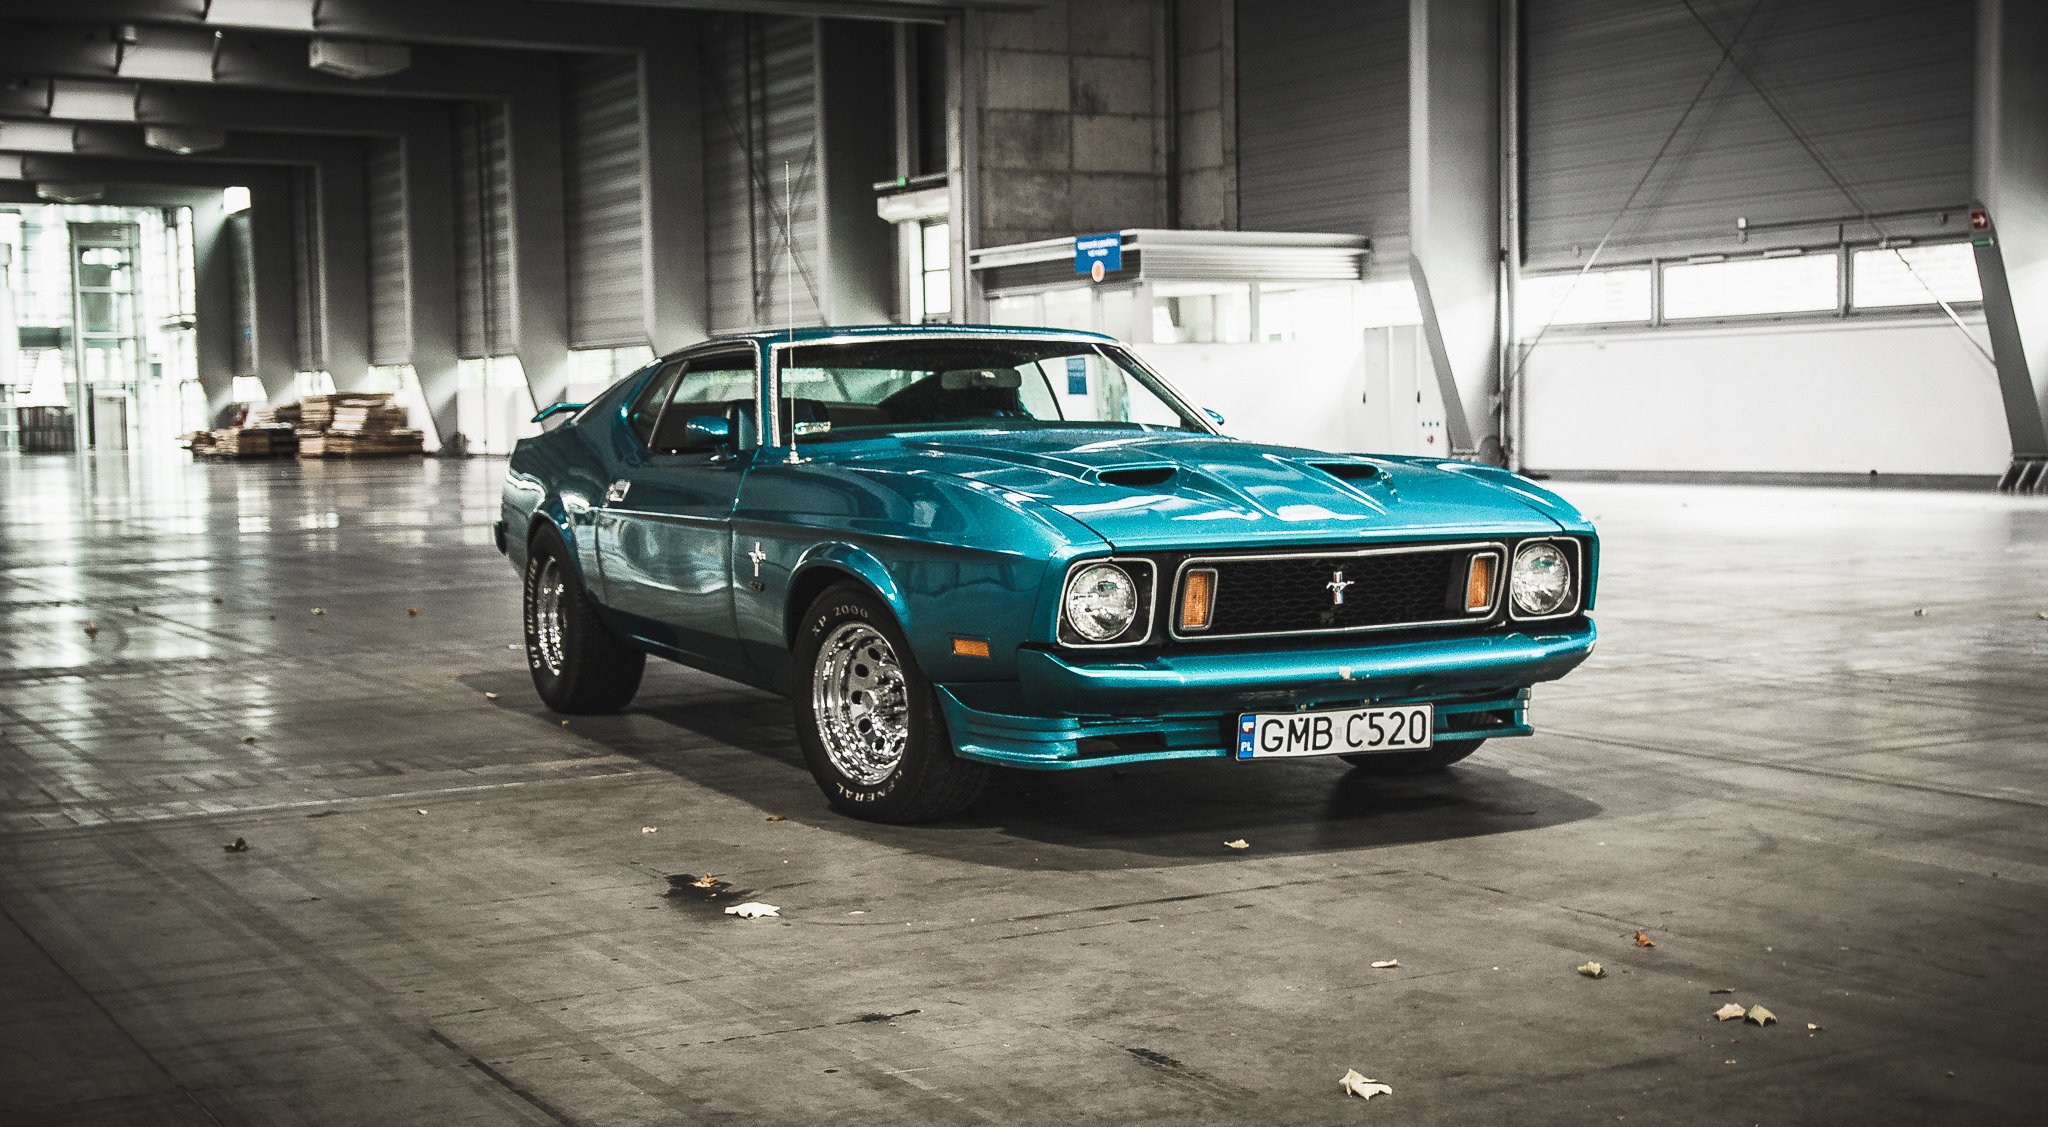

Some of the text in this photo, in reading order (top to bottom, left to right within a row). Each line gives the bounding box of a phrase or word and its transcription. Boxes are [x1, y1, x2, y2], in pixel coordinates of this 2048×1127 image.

[812, 605, 868, 636] XP 2000
[1241, 741, 1252, 752] PL
[1260, 709, 1427, 753] GMB C520
